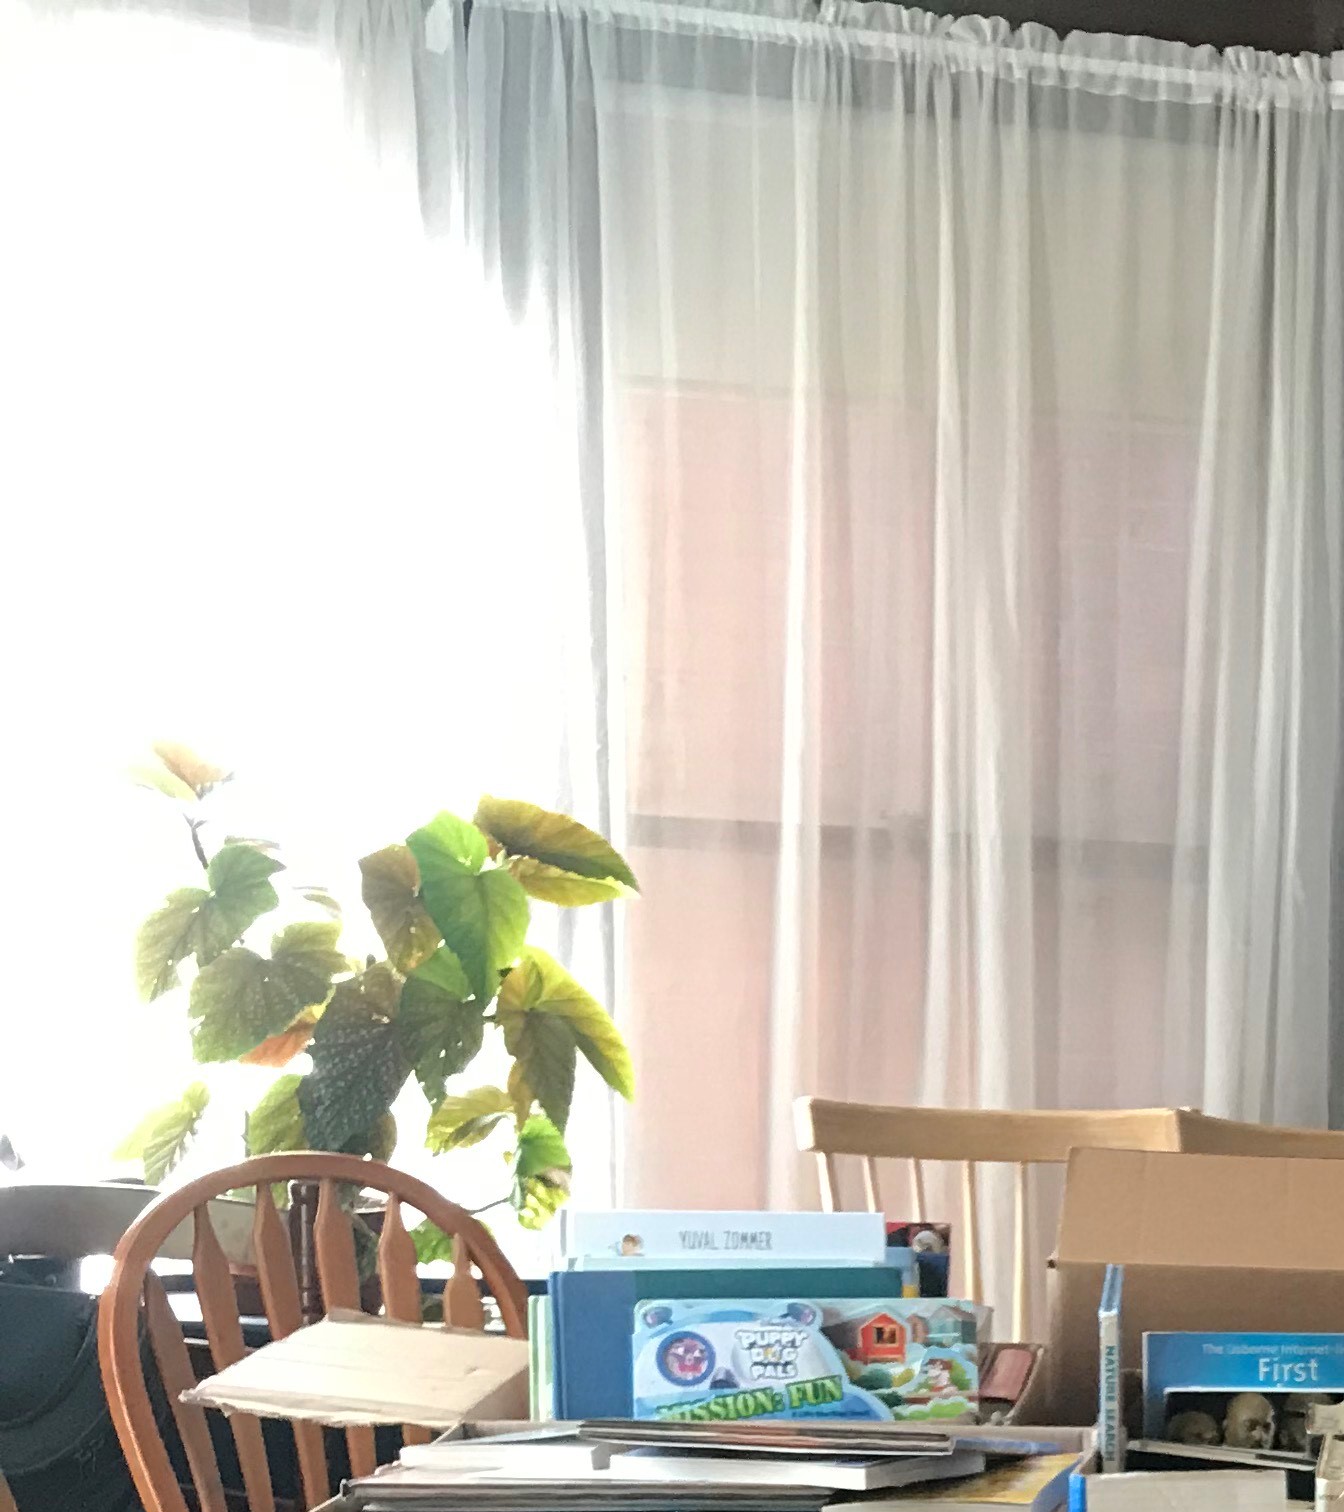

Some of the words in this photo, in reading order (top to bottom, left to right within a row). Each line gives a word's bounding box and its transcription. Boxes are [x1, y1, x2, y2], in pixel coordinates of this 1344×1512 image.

[679, 1230, 718, 1250] YUVAL
[723, 1230, 773, 1250] ZOMMER
[735, 1329, 808, 1350] PUPPY
[750, 1362, 798, 1380] PALS
[1258, 1356, 1319, 1382] First
[785, 1375, 842, 1409] FUN
